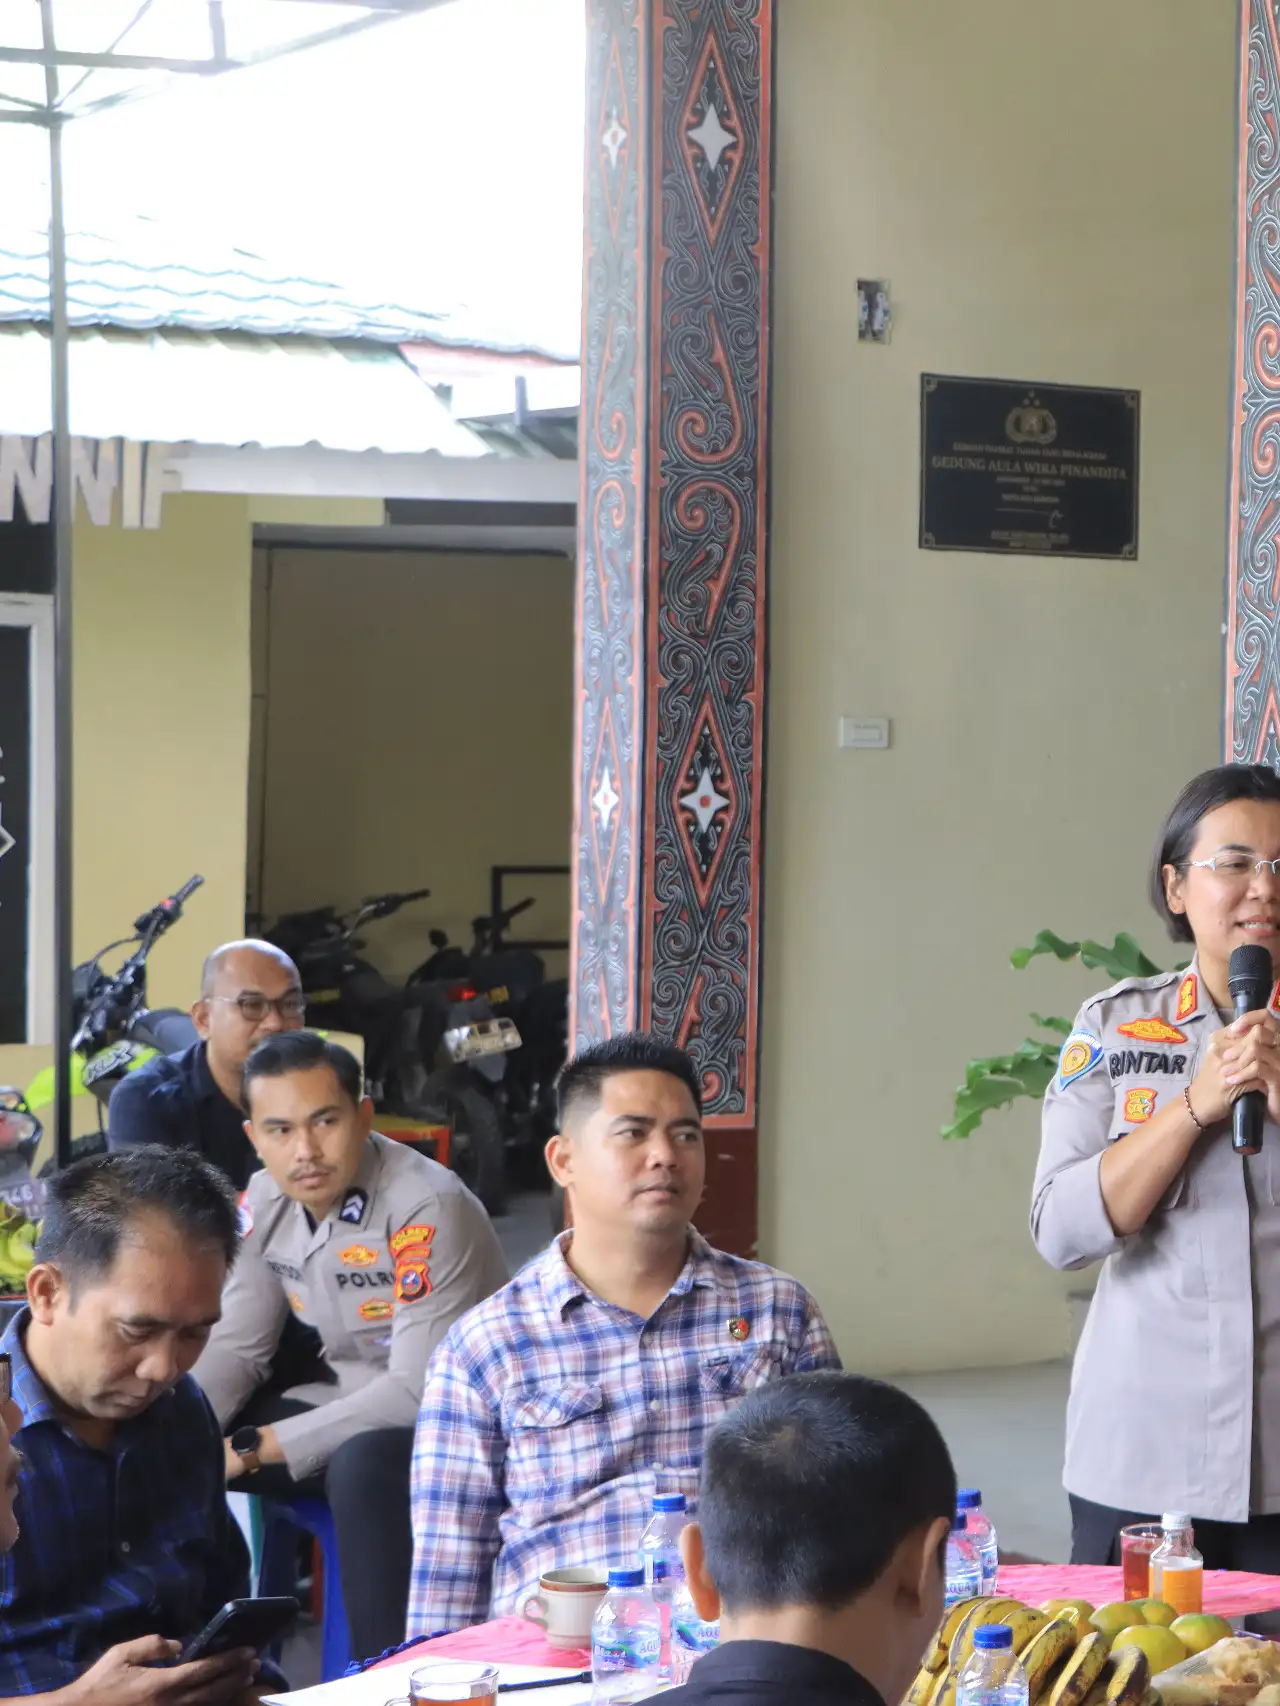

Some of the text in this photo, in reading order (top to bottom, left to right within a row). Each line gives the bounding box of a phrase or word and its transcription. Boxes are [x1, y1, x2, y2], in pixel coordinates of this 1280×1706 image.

[932, 455, 986, 471] GEDUNG
[988, 460, 1023, 474] AULA
[1109, 1050, 1188, 1080] RINTAR
[698, 1626, 720, 1639] AQU
